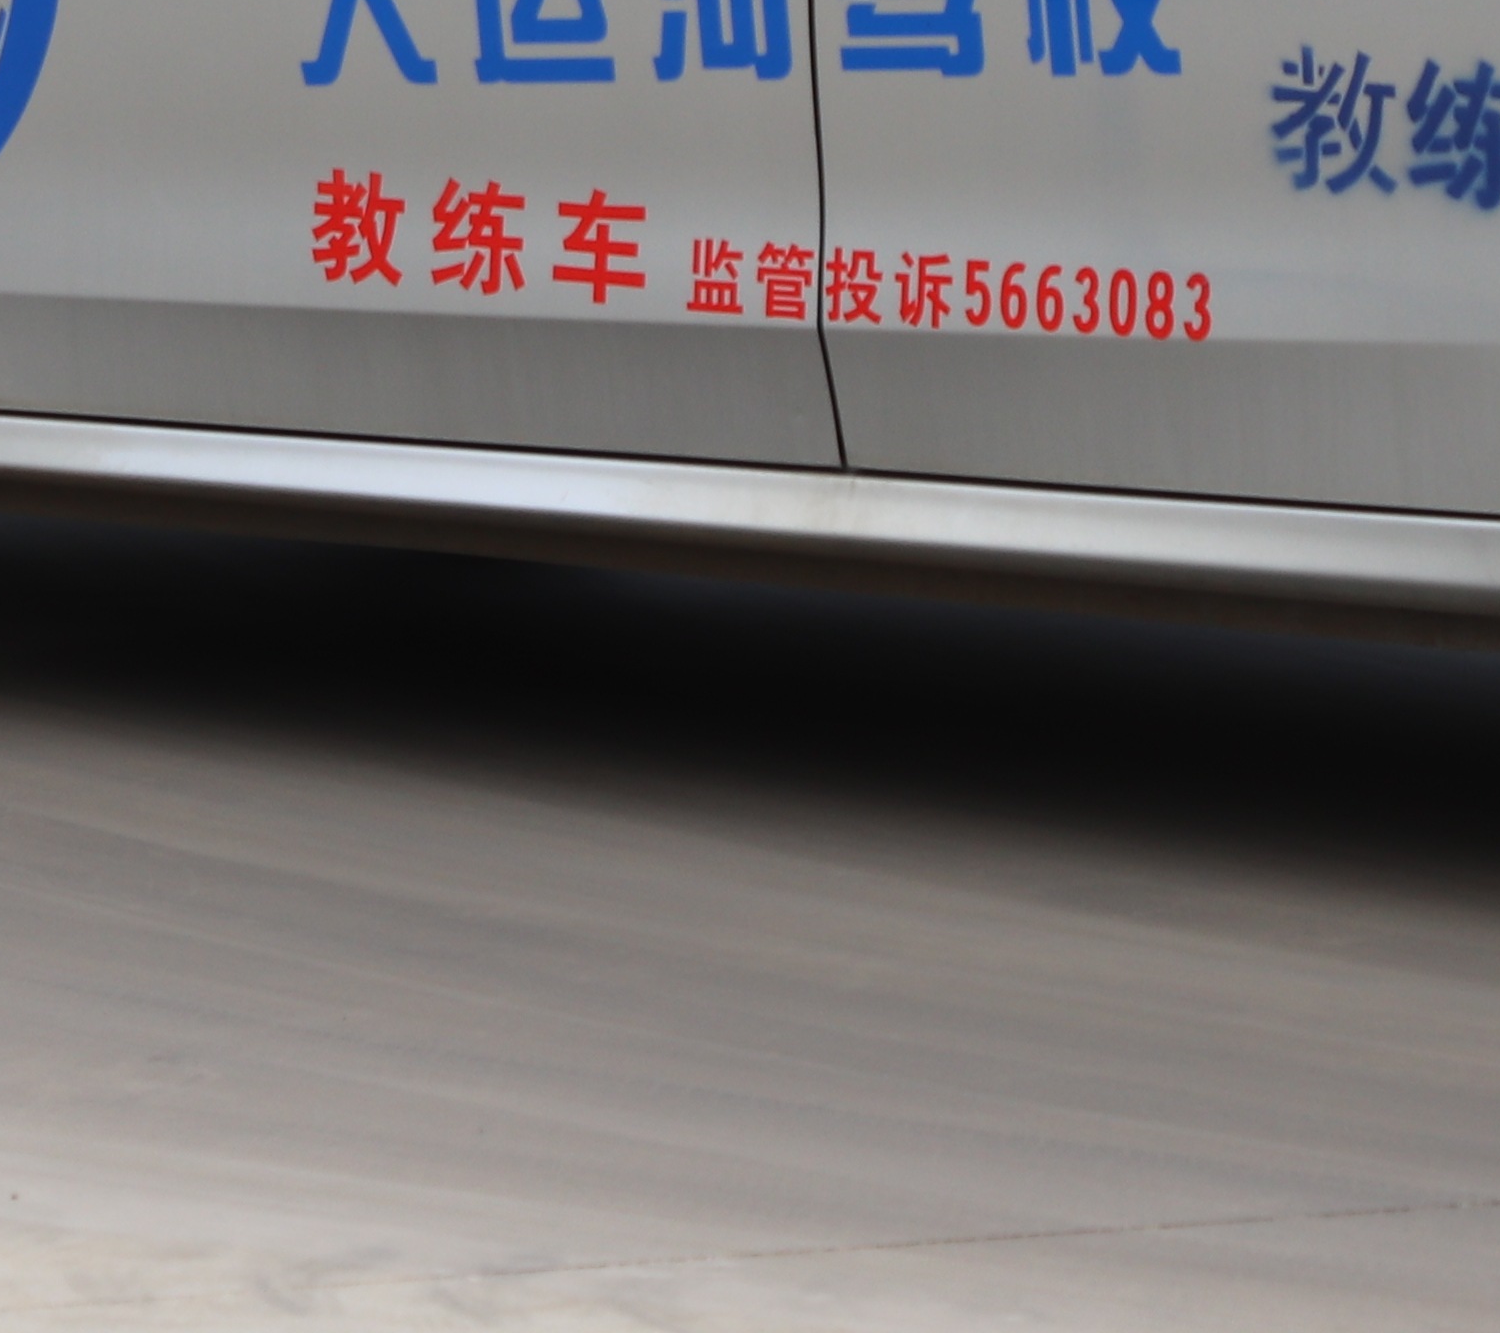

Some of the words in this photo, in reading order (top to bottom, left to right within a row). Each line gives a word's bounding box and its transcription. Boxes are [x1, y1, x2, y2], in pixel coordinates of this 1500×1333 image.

[310, 167, 648, 306] 教练车
[685, 237, 1213, 343] 监管投诉5663083
